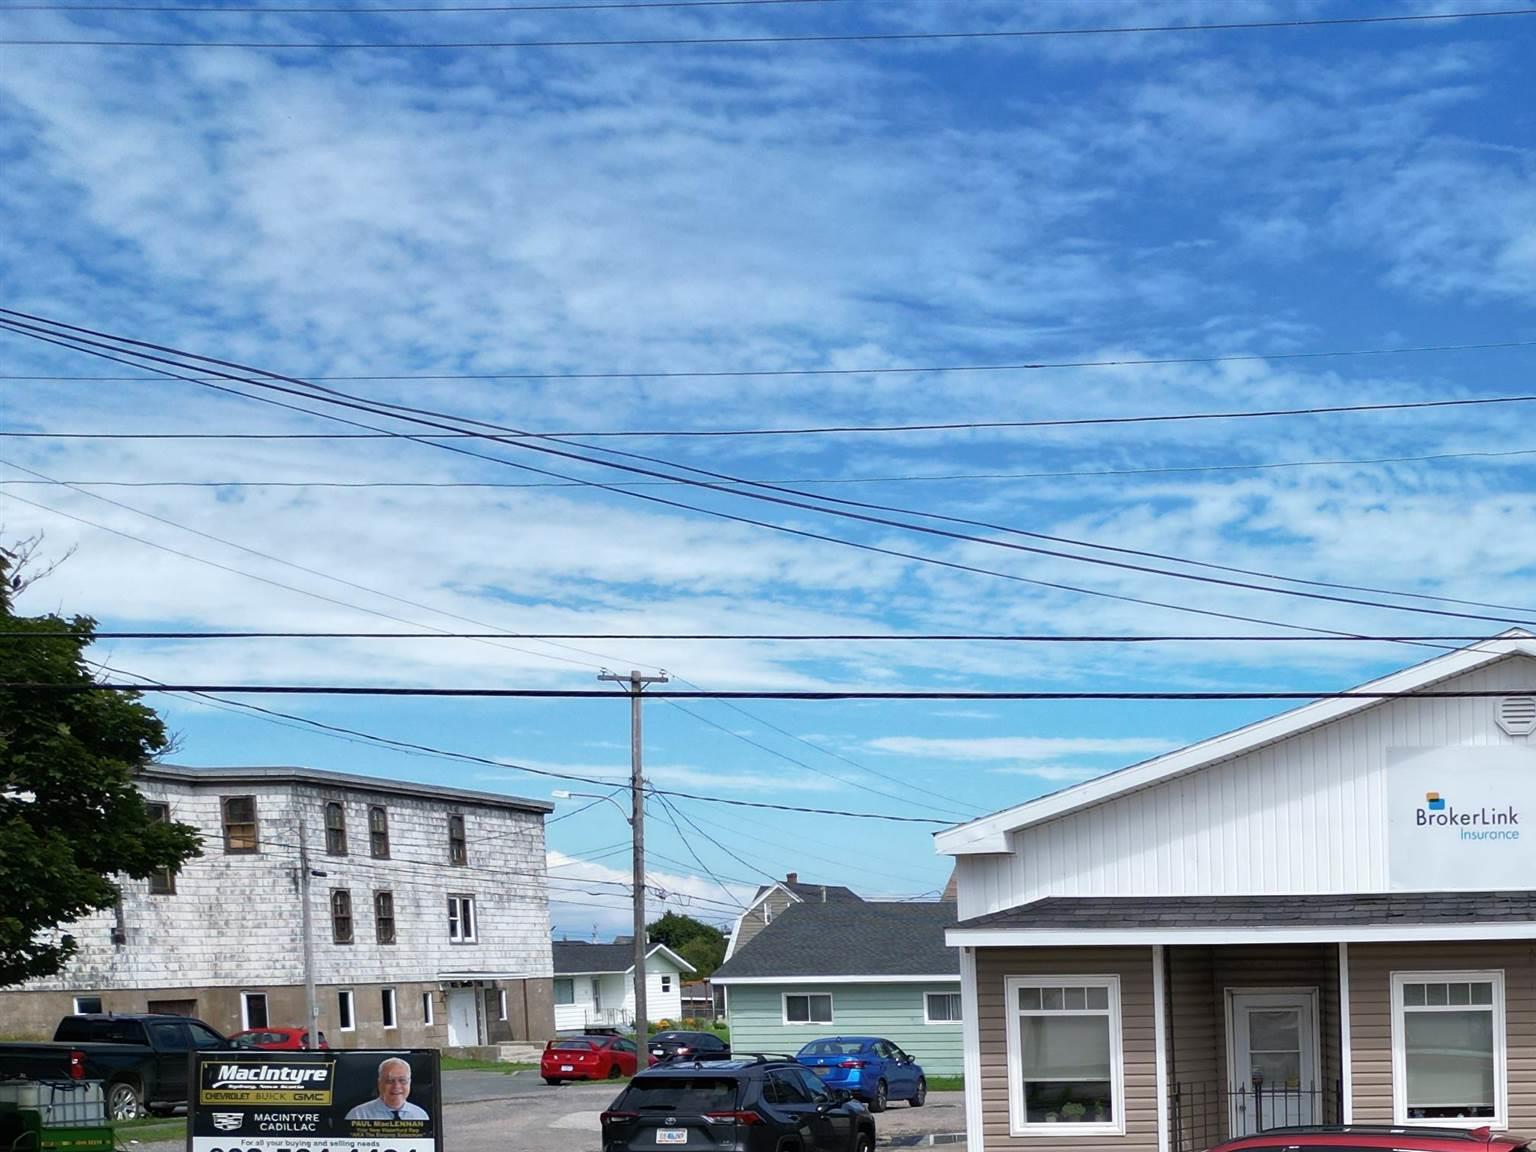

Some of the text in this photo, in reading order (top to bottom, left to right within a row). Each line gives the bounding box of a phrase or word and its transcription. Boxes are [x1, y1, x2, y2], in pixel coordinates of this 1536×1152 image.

[1416, 806, 1519, 826] BrokerLink
[1460, 828, 1519, 840] Insurance
[218, 1065, 327, 1083] MacIntyre
[293, 1093, 324, 1101] GMC
[254, 1113, 320, 1122] MACINTYRE
[260, 1123, 316, 1131] CADILLAC
[285, 1140, 311, 1148] buying
